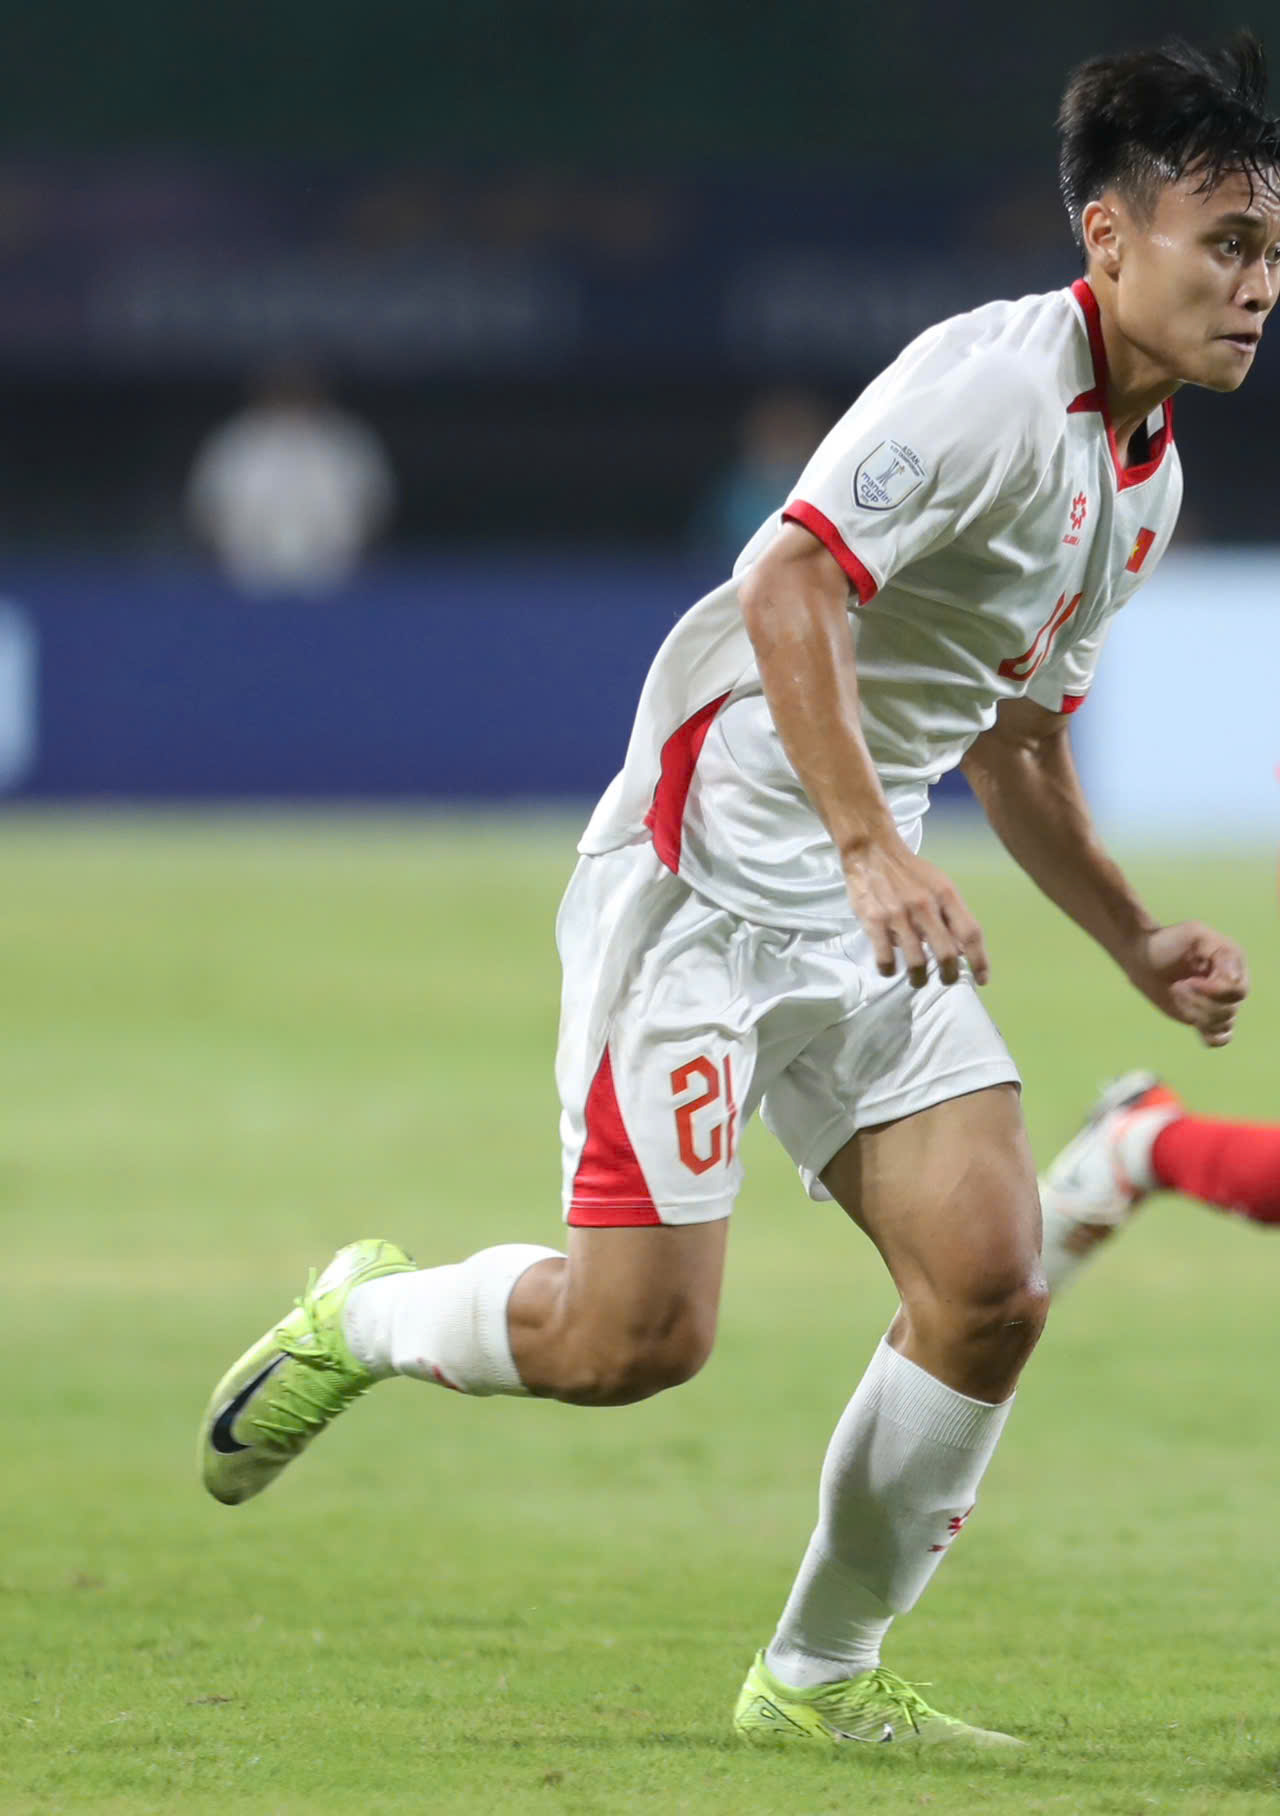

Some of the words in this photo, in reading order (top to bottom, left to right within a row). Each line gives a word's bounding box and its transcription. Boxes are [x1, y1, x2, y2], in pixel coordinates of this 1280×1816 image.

[860, 484, 879, 502] CUP
[861, 472, 892, 504] mandiri
[670, 1053, 738, 1176] 21
